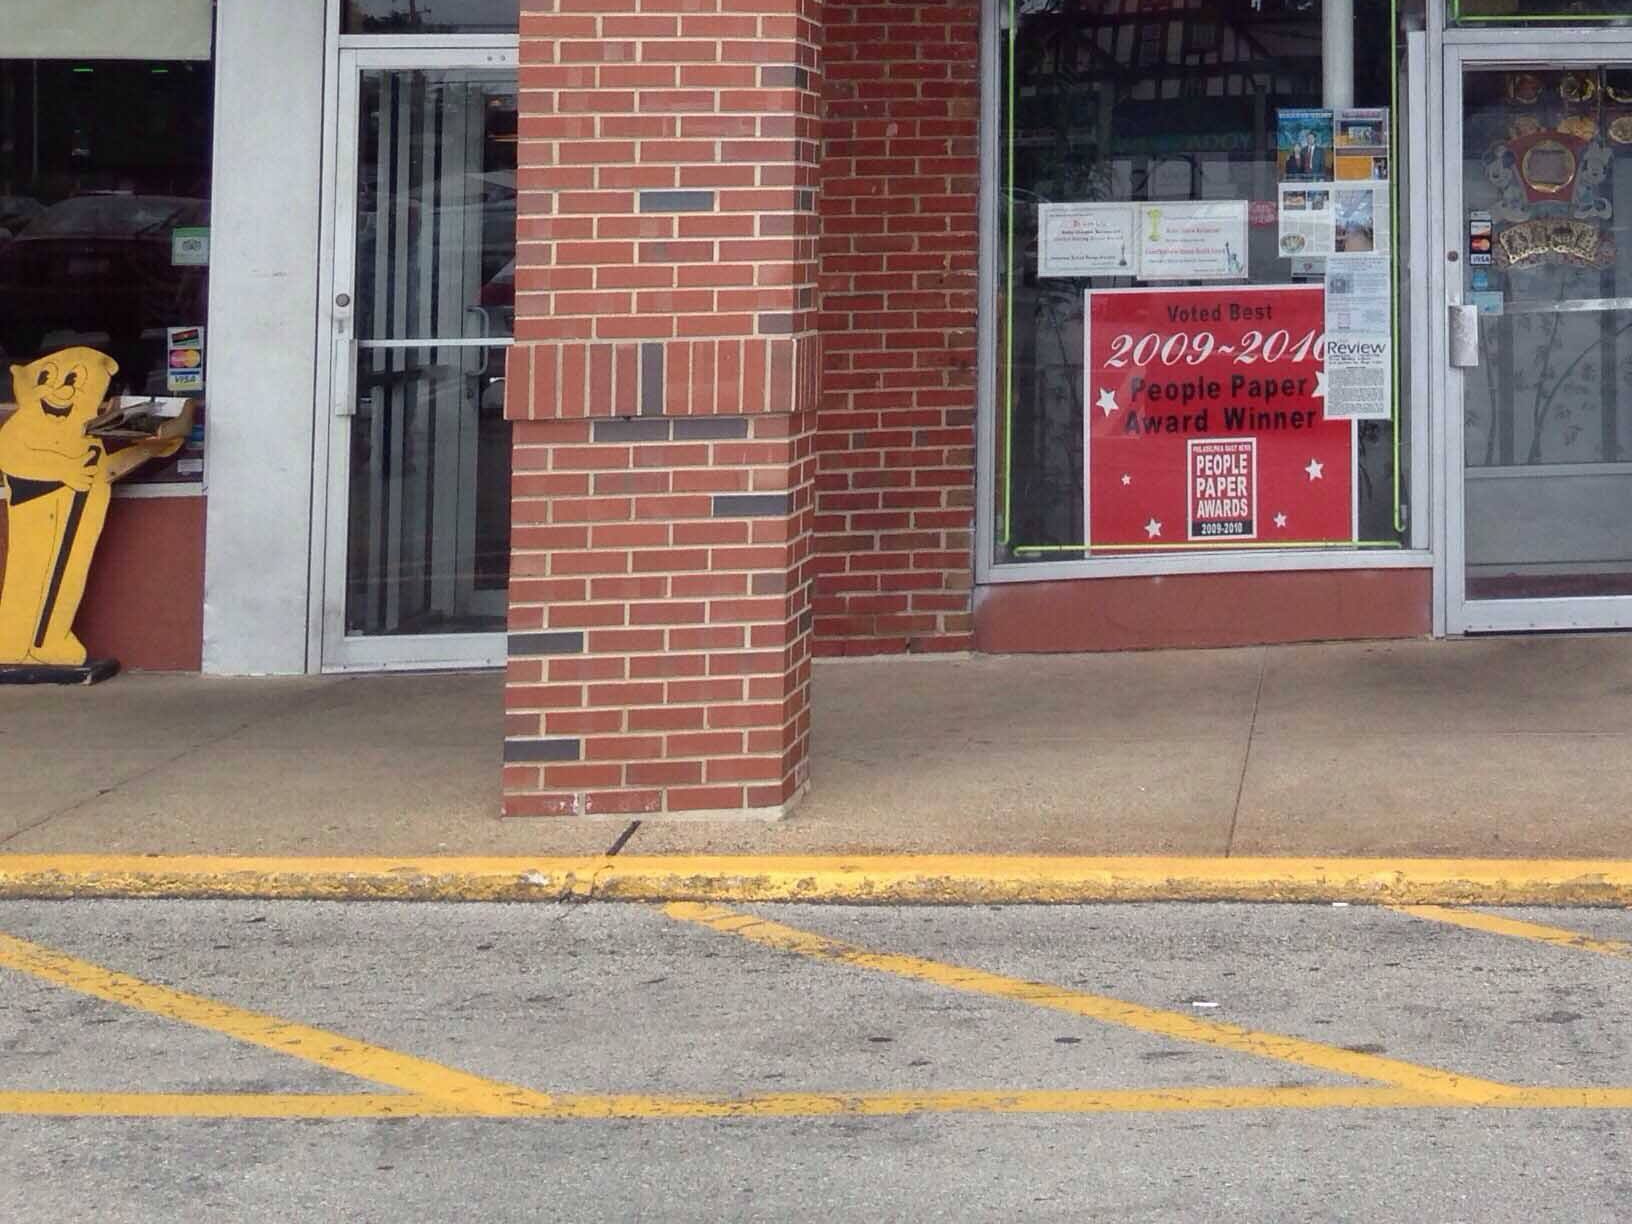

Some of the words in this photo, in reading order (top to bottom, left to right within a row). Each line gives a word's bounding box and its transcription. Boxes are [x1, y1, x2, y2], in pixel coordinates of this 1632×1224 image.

[1167, 303, 1221, 323] Voted
[1229, 303, 1273, 322] Best
[1327, 341, 1386, 354] Review
[1131, 375, 1220, 405] People
[1230, 374, 1307, 404] Paper
[1124, 406, 1208, 435] Award
[1223, 407, 1317, 433] Winner
[1196, 454, 1248, 476] PEOPLE
[1196, 476, 1248, 498] PAPER
[1196, 498, 1249, 519] AWARDS
[1201, 522, 1243, 535] 2009-2010
